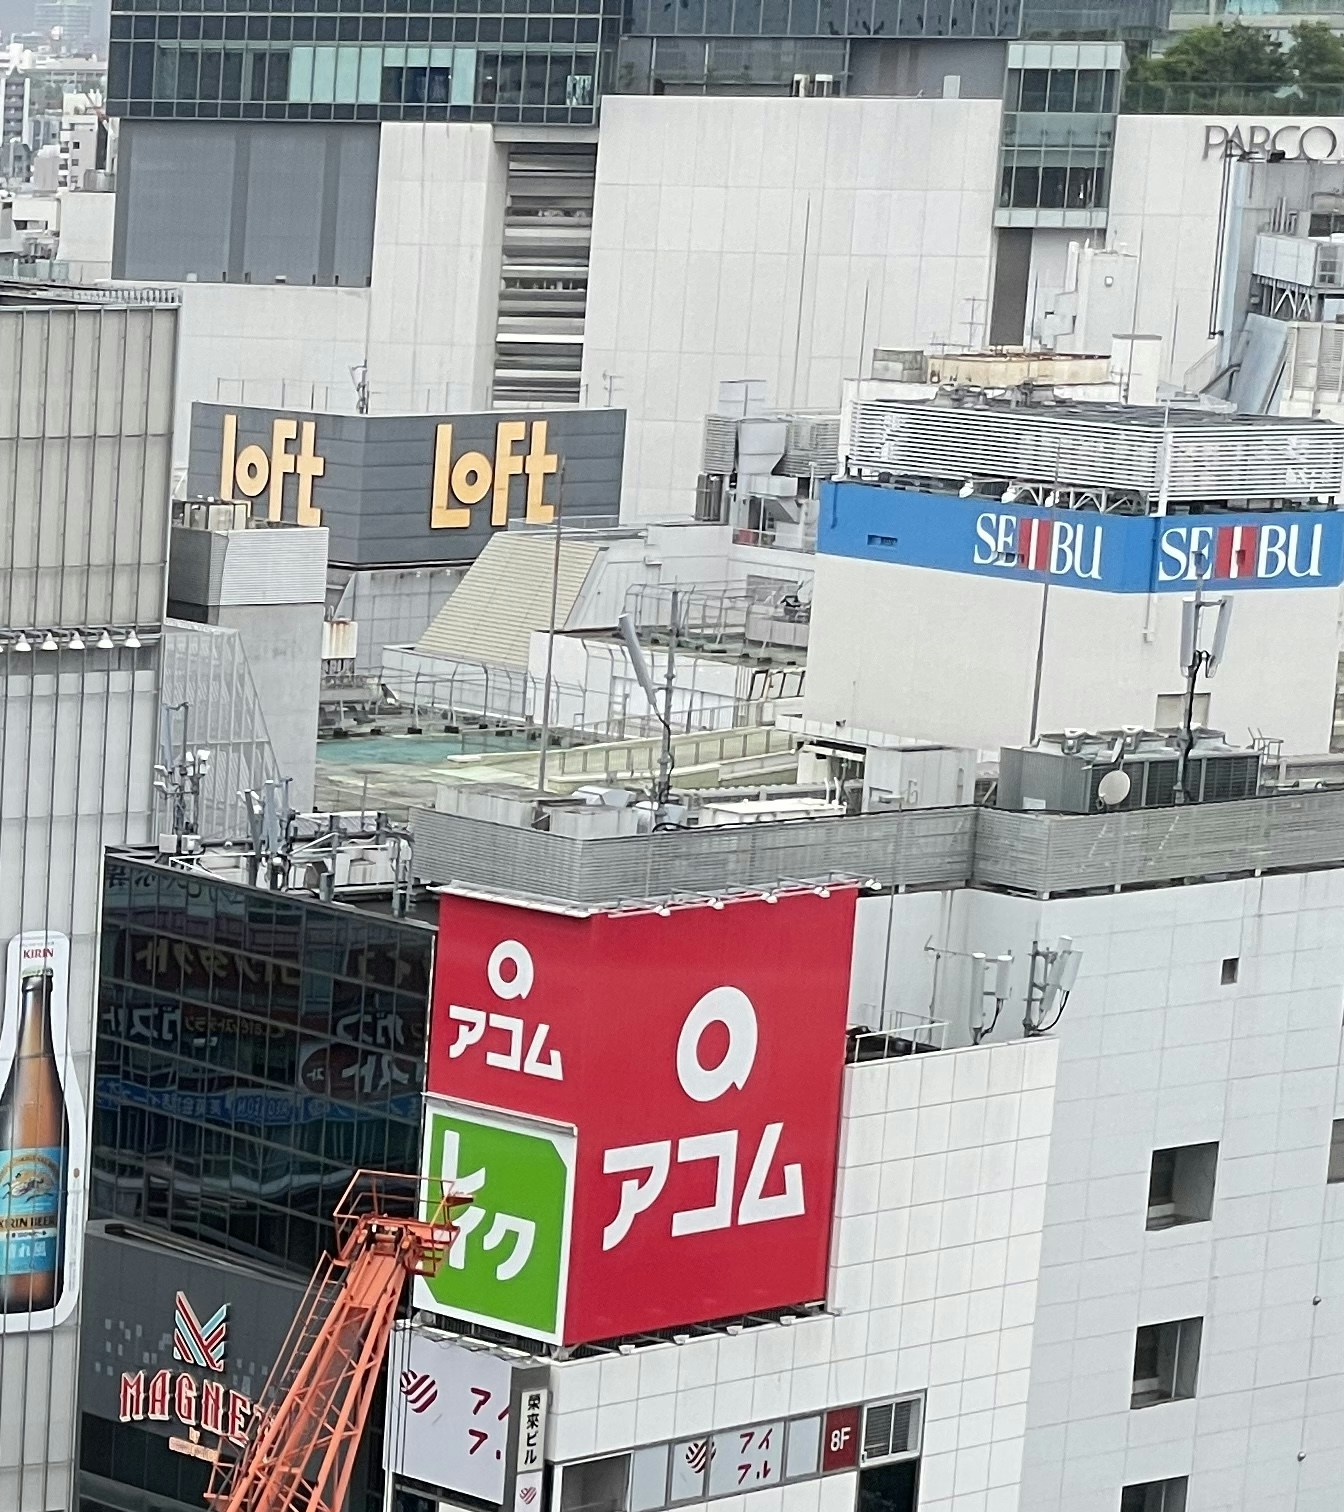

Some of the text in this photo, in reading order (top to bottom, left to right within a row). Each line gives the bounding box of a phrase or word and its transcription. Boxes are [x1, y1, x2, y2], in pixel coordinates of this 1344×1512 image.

[1203, 124, 1338, 161] PARCO
[973, 512, 1103, 580] SEIBU
[1158, 523, 1323, 582] SEIBU
[22, 948, 54, 960] KIRIN
[449, 1005, 564, 1082] アコム
[603, 1122, 805, 1252] アコム
[119, 1369, 264, 1448] MAGNE
[739, 1425, 851, 1454] アイ 8F
[736, 1458, 772, 1484] フル
